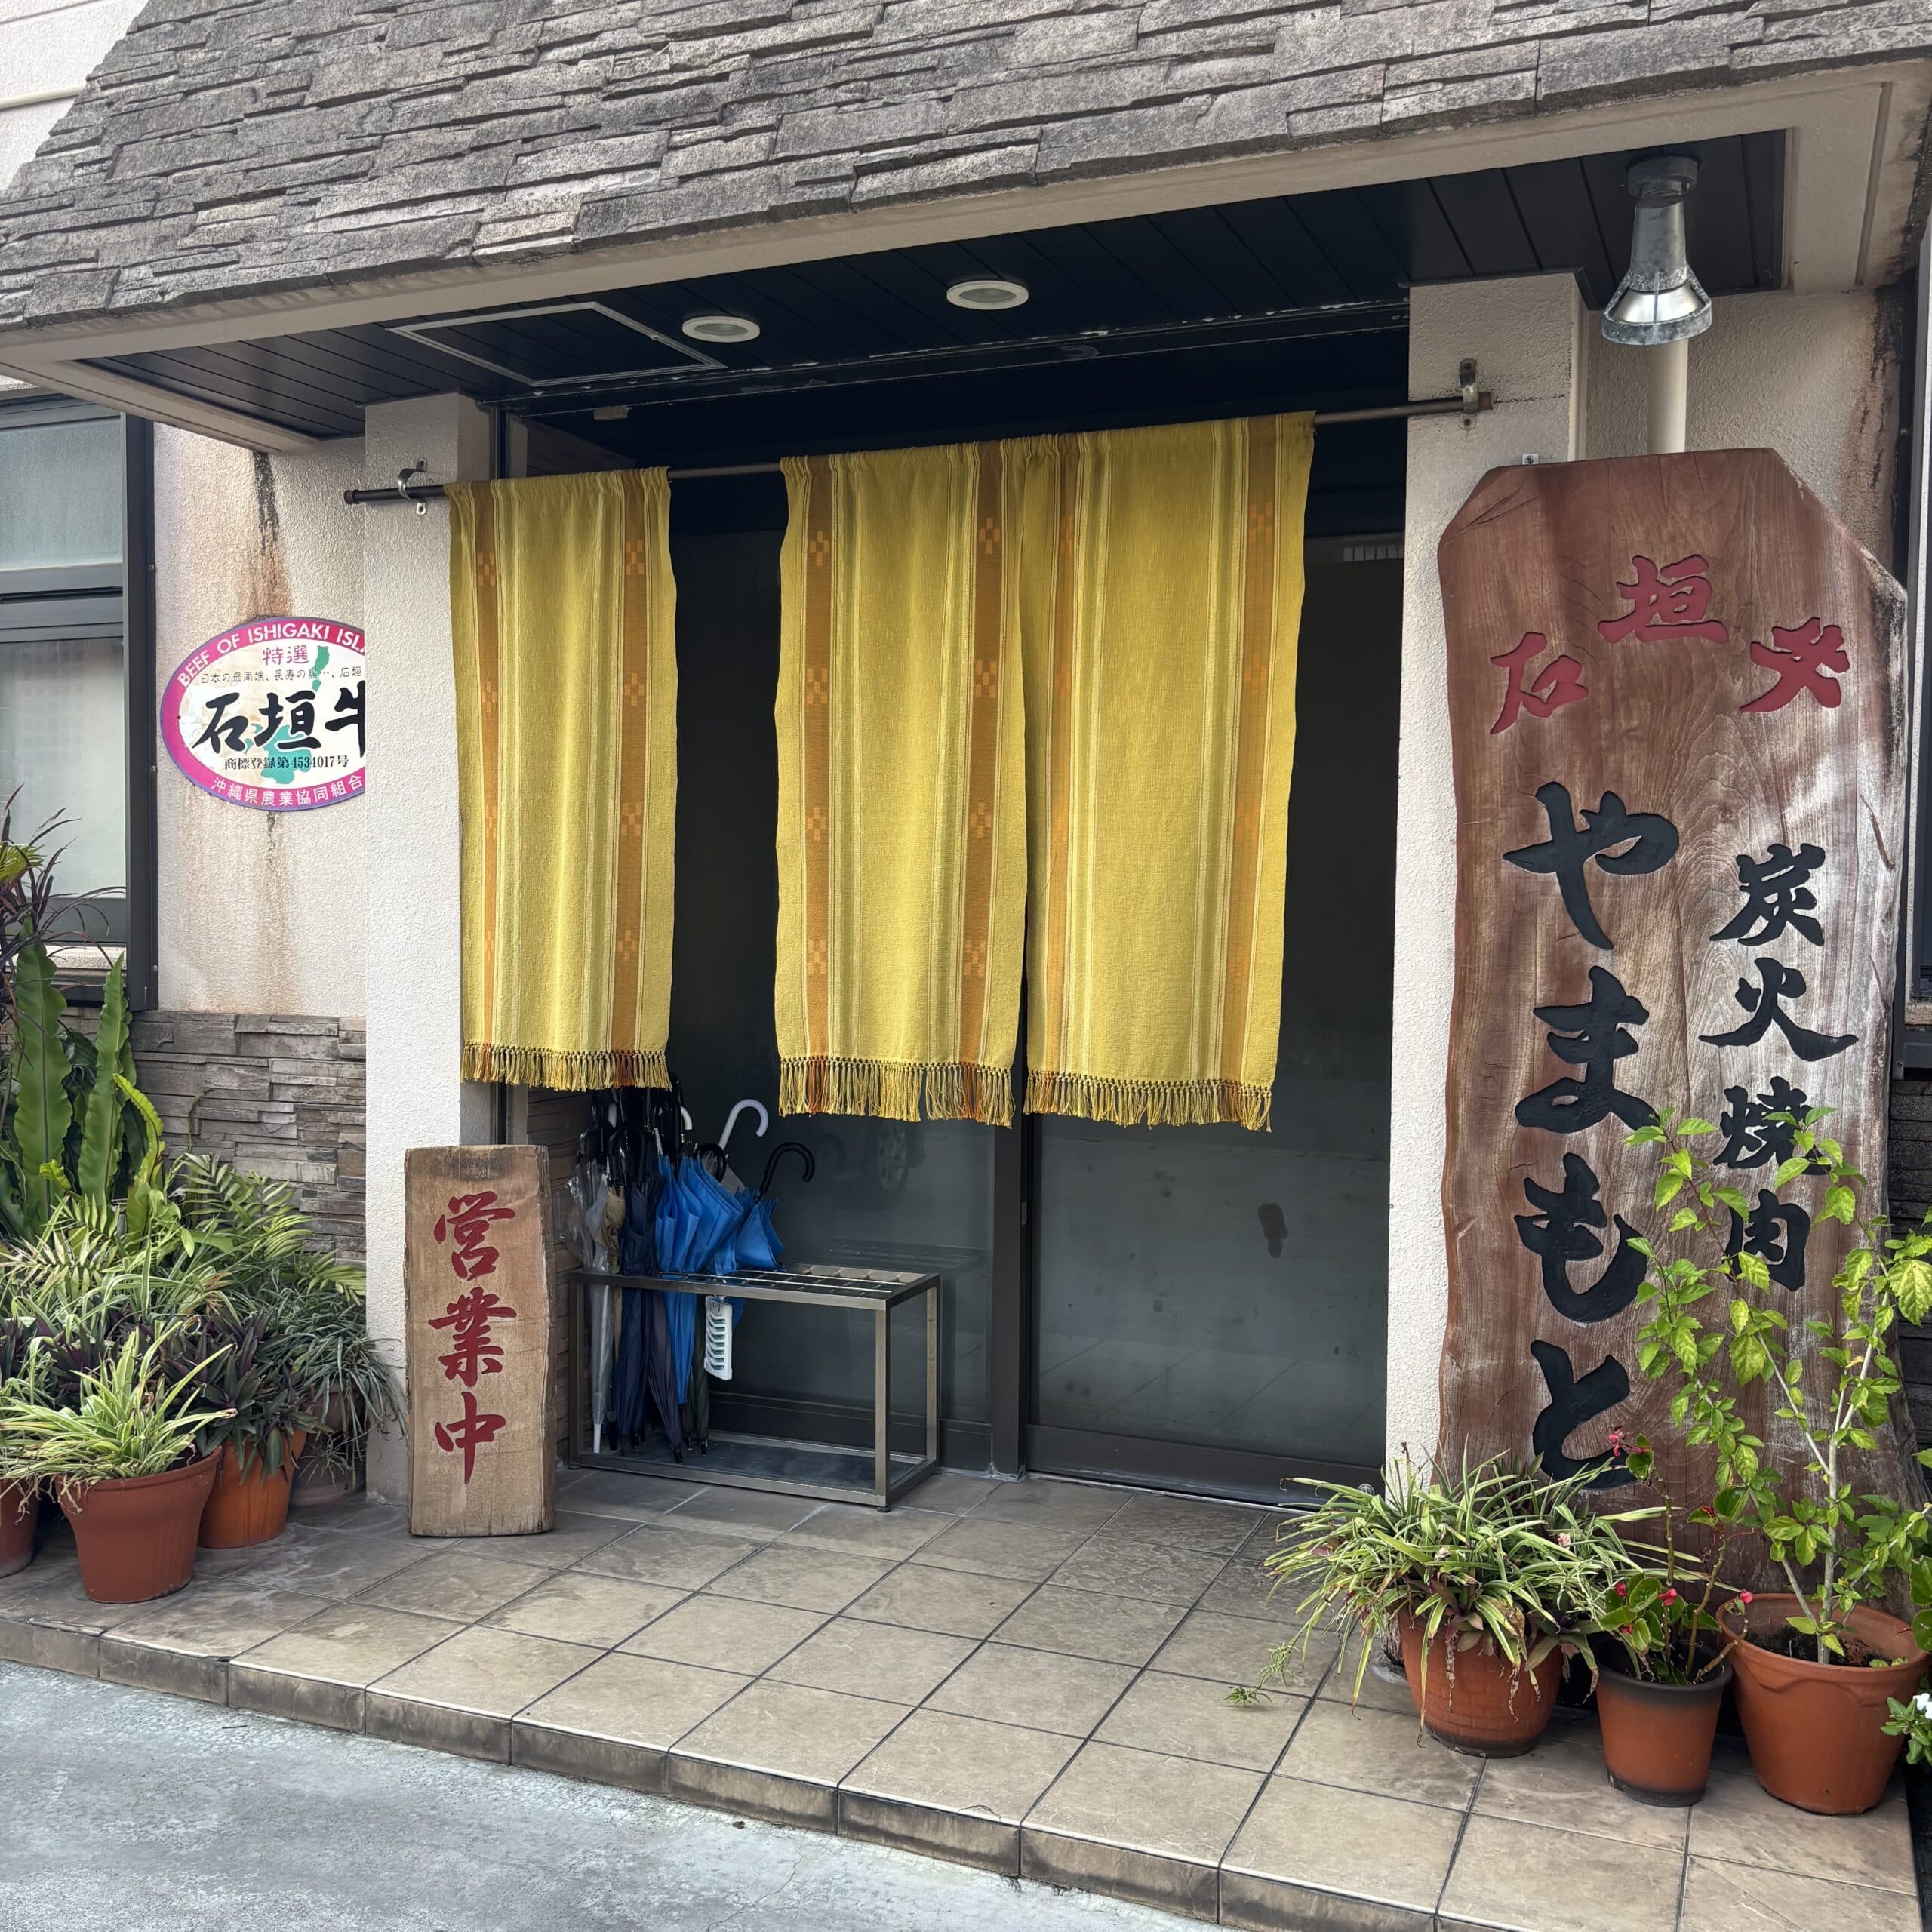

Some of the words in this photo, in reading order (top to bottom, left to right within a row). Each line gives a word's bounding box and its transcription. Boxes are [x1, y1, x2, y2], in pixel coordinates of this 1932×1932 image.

[177, 650, 209, 688] BEEF
[217, 633, 240, 654] OF
[248, 623, 330, 644] ISHIGAKI
[263, 645, 309, 666] 特選
[211, 774, 363, 806] 沖縄県農業協同組合
[225, 755, 349, 770] 商標登録第4534017号
[1698, 843, 1860, 1291] 炭火焼肉
[1503, 781, 1679, 1490] やまもと
[428, 1190, 517, 1484] 営業中
